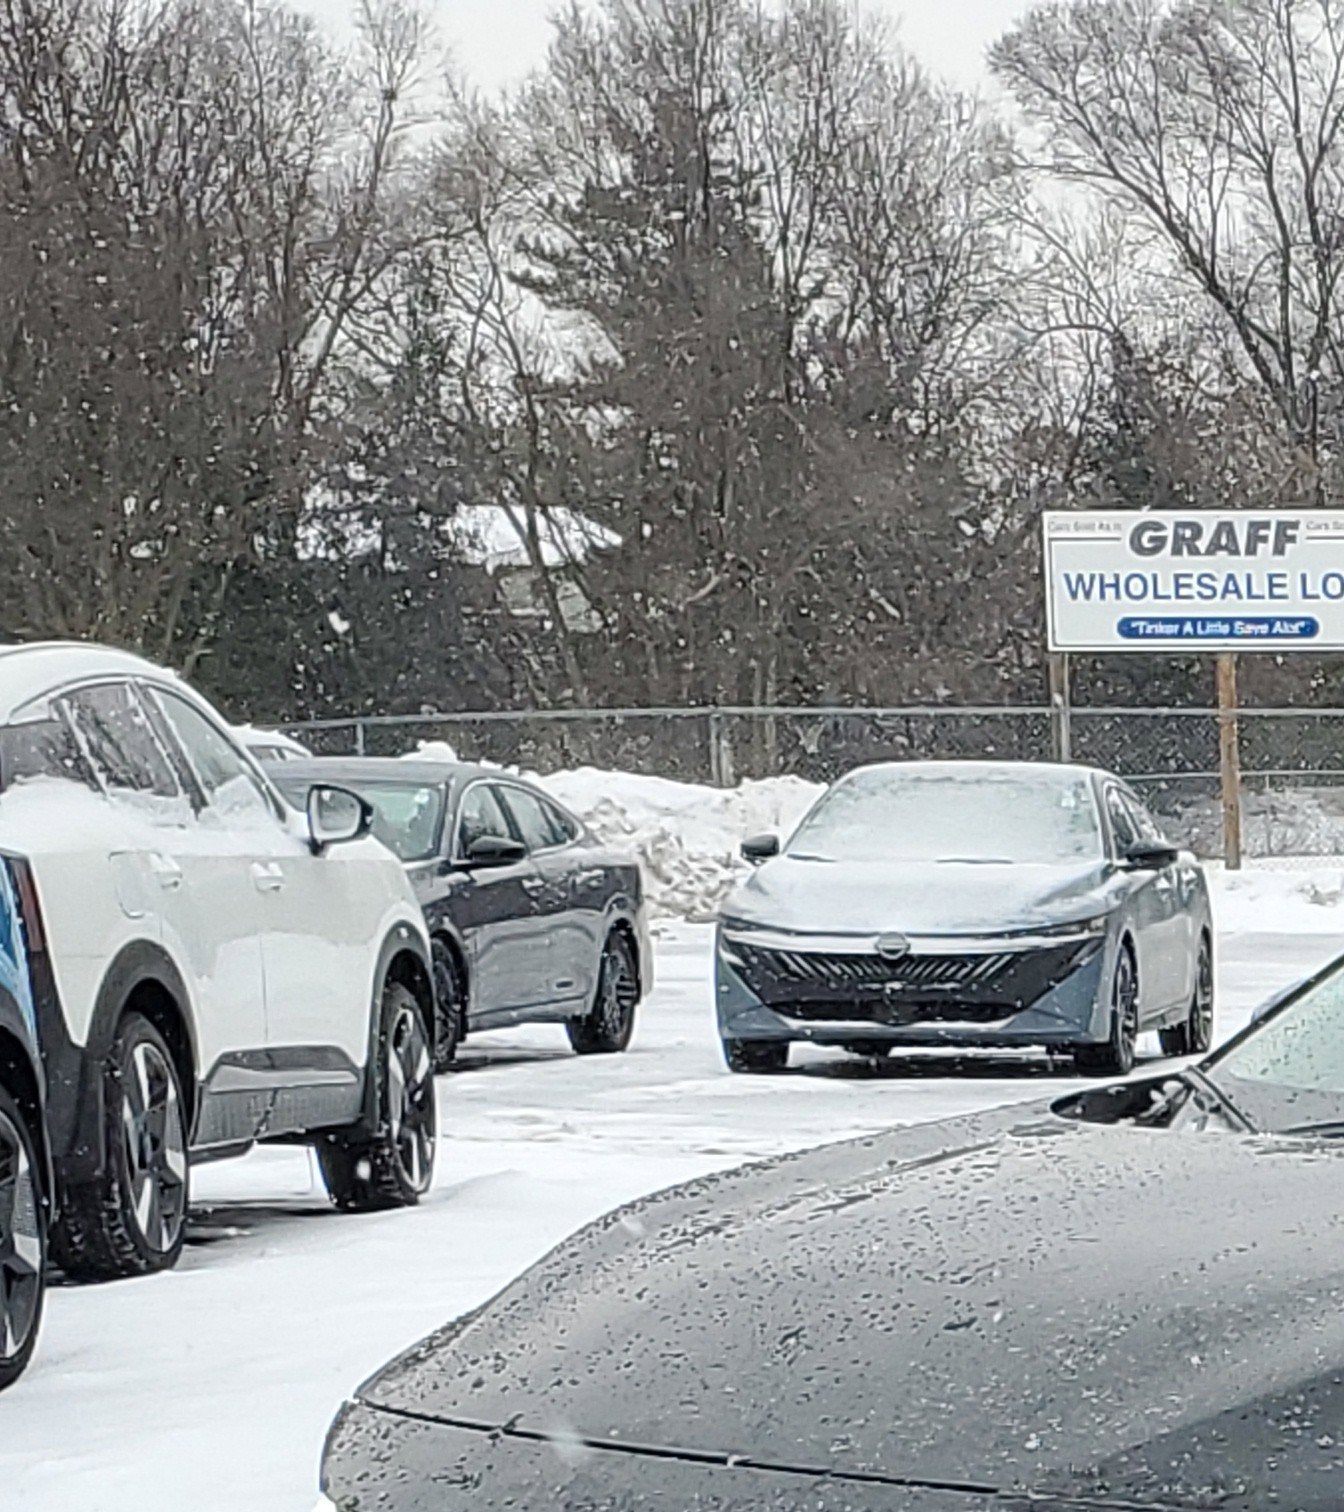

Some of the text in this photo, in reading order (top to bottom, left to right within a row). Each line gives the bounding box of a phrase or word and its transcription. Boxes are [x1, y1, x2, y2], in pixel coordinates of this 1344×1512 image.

[1129, 520, 1300, 556] GRAFF
[1063, 572, 1290, 601] WHOLESALE
[1182, 620, 1194, 636] A
